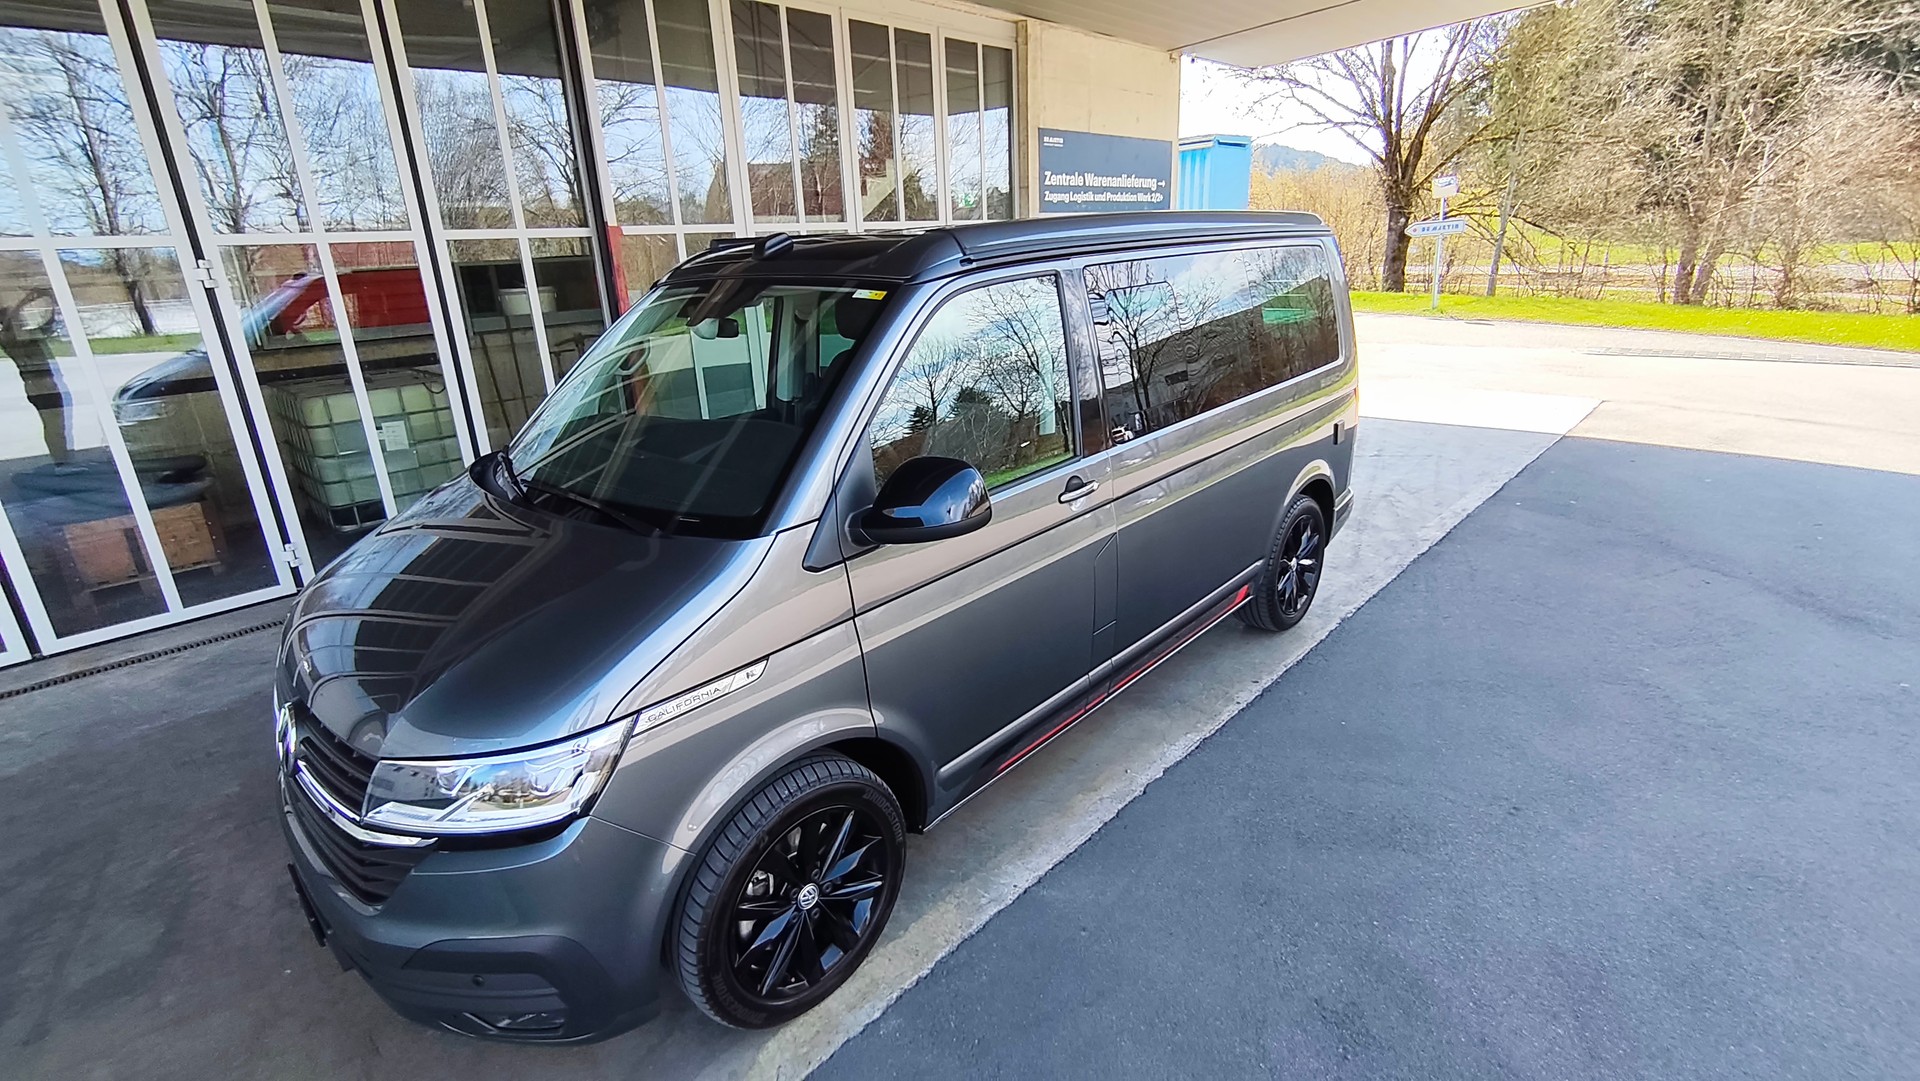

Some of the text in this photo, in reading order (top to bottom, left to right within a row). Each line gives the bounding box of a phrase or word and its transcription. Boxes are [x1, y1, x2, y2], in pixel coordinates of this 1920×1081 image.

[1044, 171, 1157, 190] Zentrale Warenanlieferung
[1044, 191, 1069, 203] Zugang
[1070, 191, 1094, 203] Logistik
[1095, 192, 1106, 201] und
[1107, 192, 1137, 202] Produktion
[1137, 193, 1151, 202] Werk
[647, 687, 721, 722] CALIFORNIA
